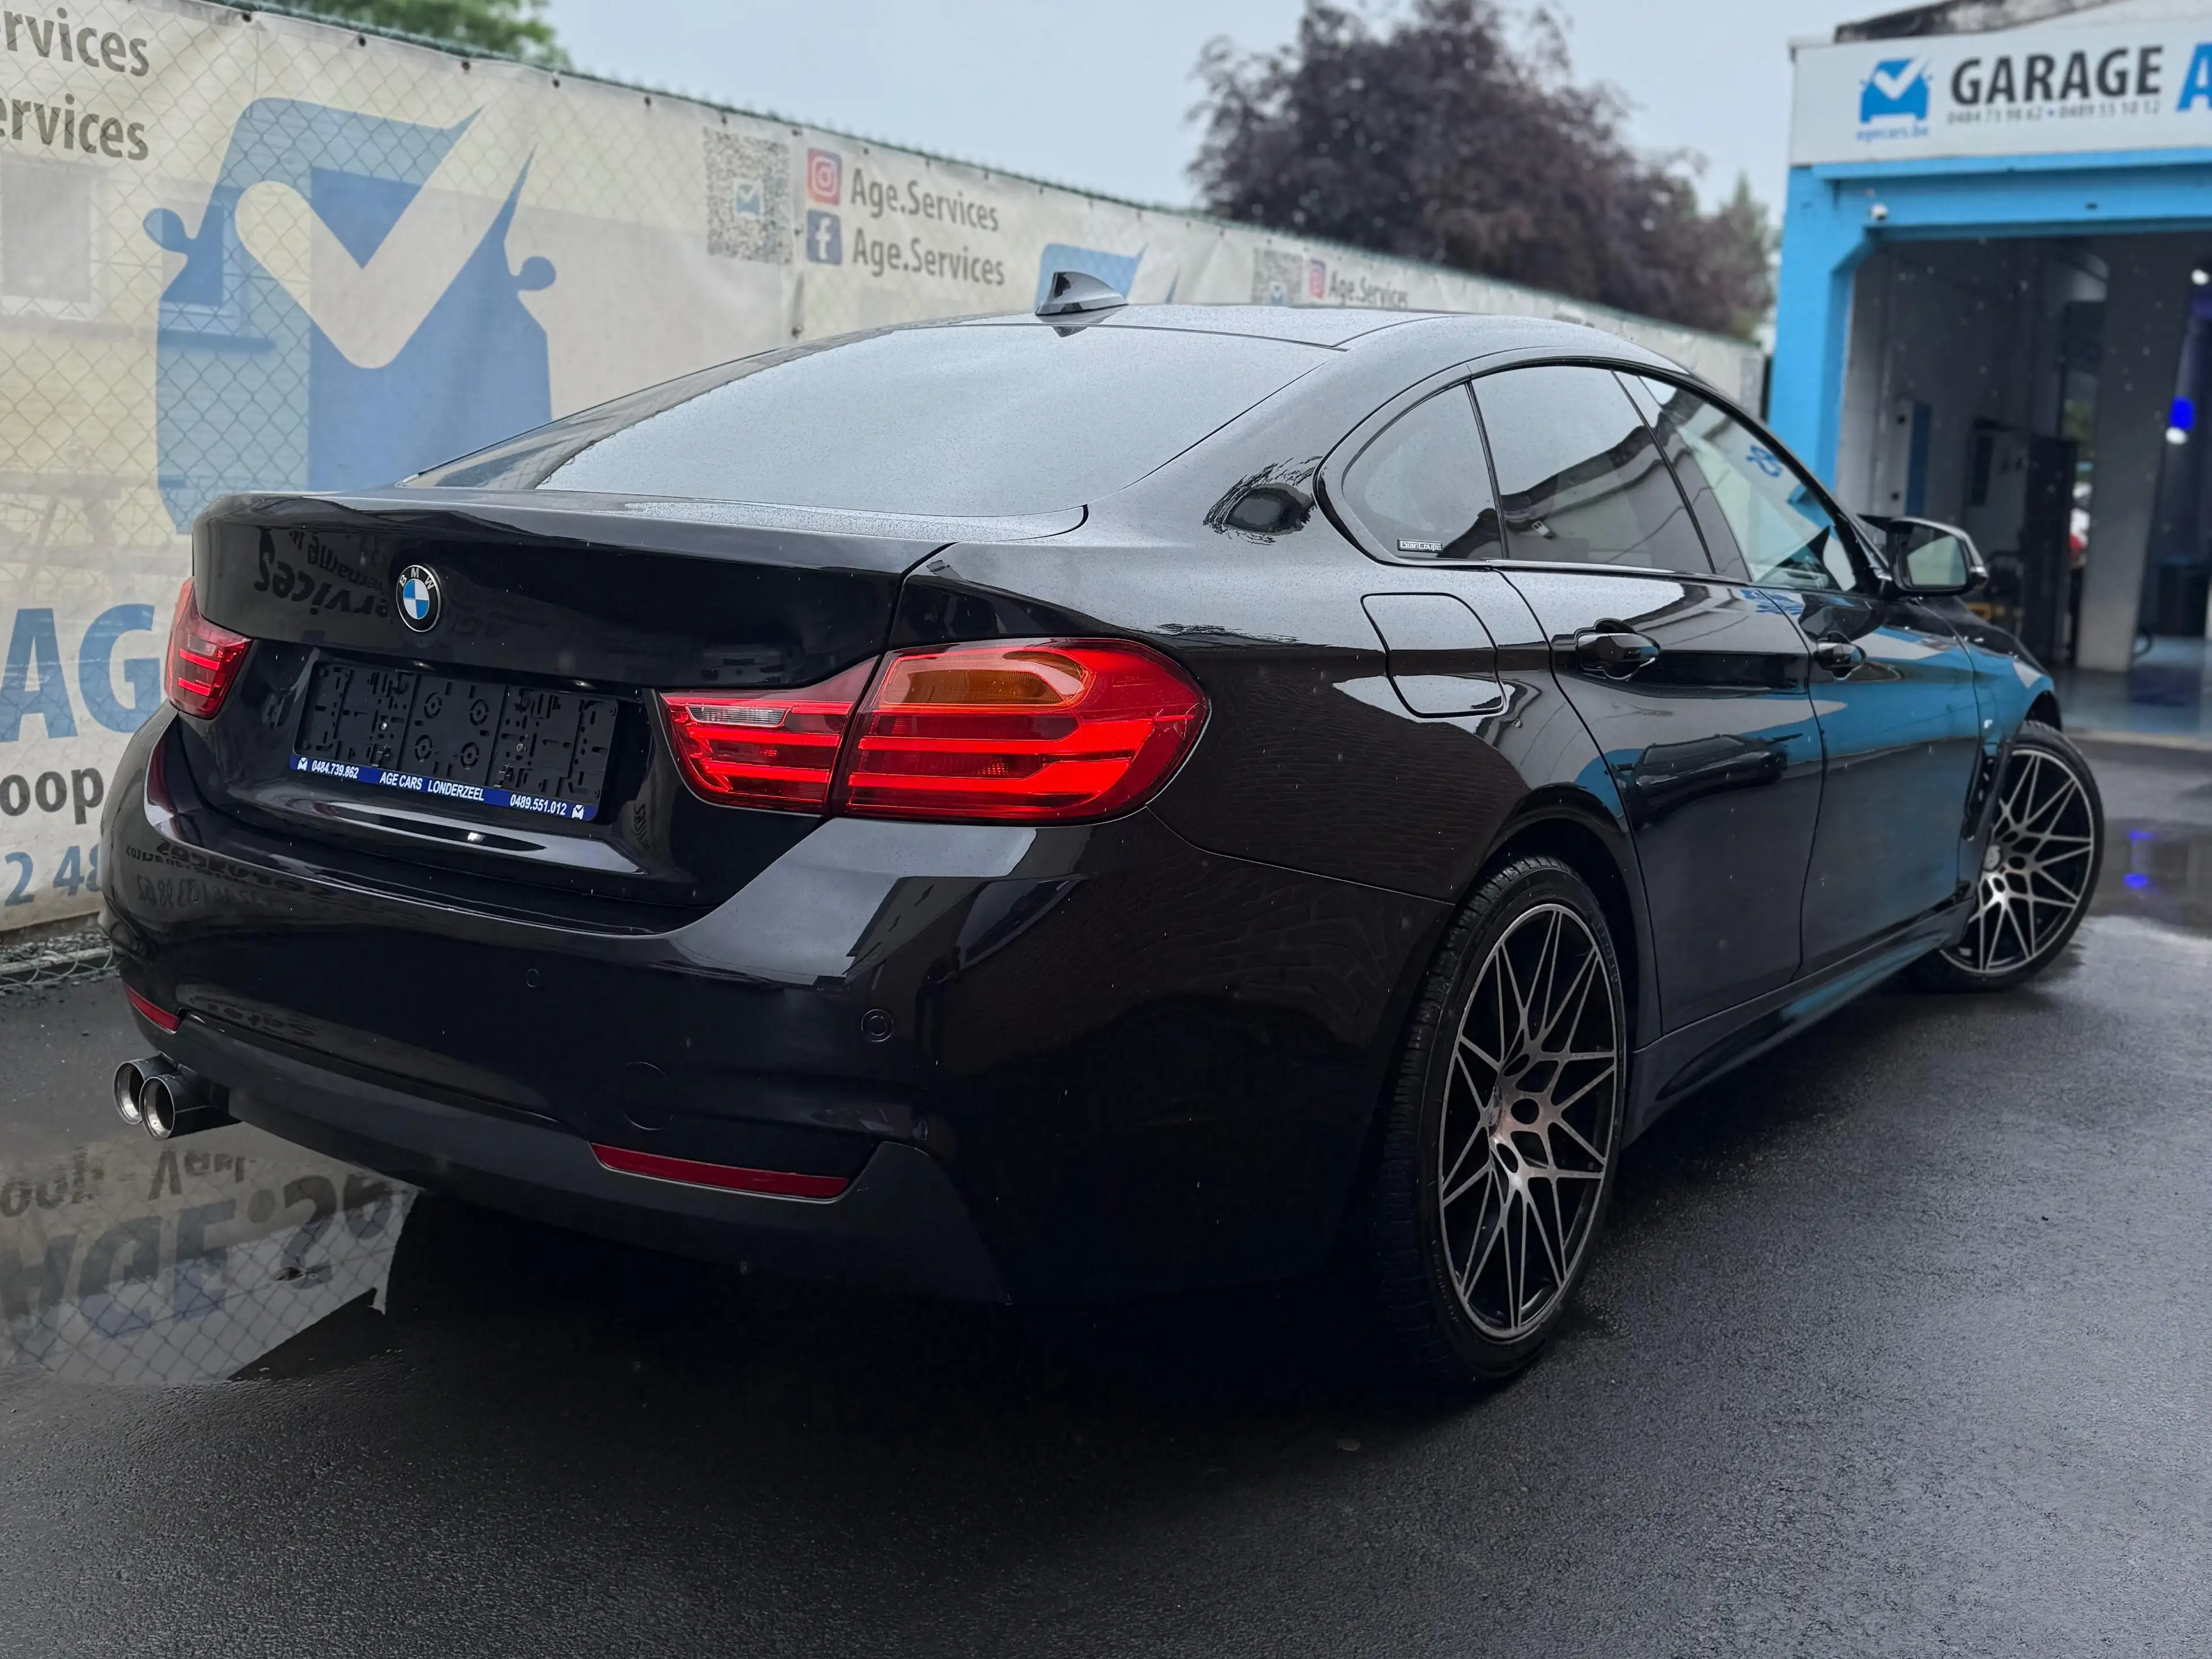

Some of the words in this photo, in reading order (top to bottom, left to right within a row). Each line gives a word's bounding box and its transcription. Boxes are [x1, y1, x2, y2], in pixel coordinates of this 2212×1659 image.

[1950, 45, 2164, 107] GARAGE
[0, 93, 149, 161] rvices
[850, 167, 999, 233] Age.Services
[852, 227, 1005, 286] Age.Services
[399, 567, 435, 590] BMW
[311, 759, 360, 779] 0484.739.862
[379, 771, 402, 786] AGE
[399, 775, 423, 791] CARS
[427, 779, 485, 801] LONDERZEEL
[510, 794, 568, 816] 0489.551.012
